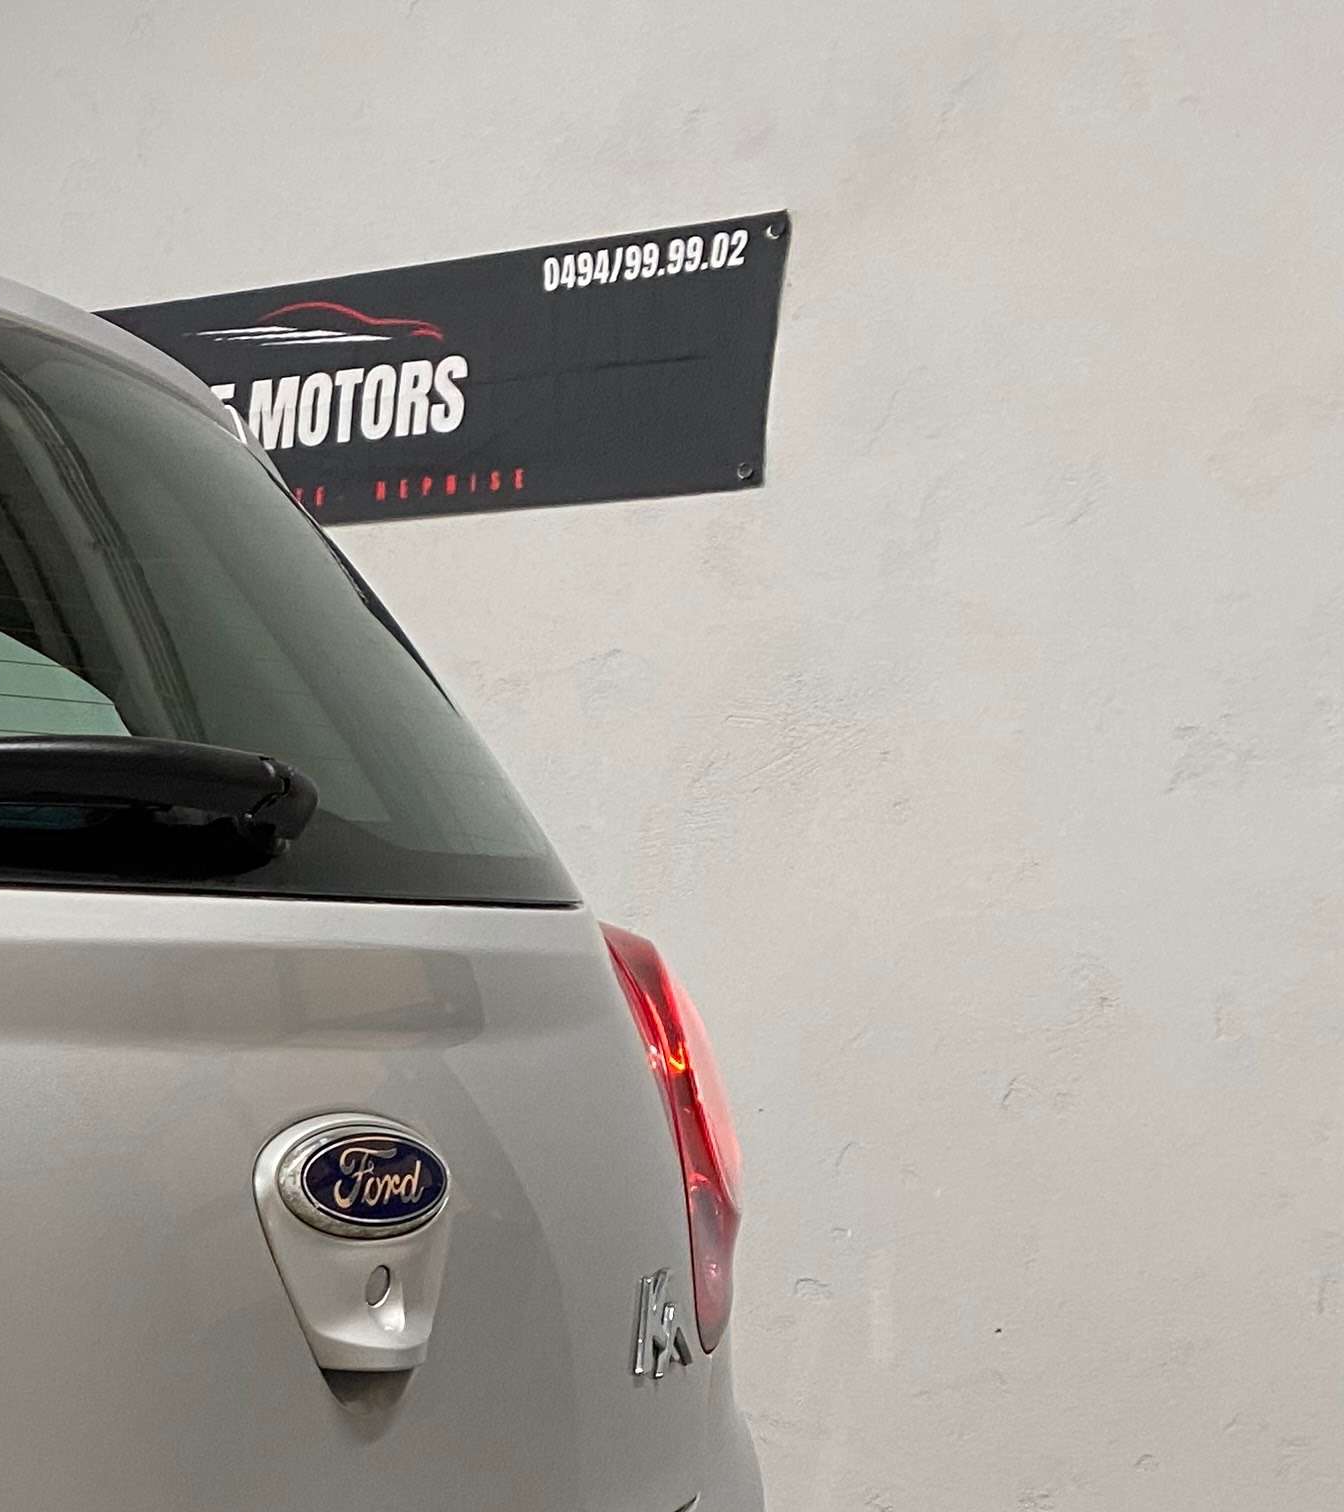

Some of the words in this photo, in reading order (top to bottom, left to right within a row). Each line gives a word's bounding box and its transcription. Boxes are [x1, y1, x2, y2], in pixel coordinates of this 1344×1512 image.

[543, 229, 749, 292] 0494/99.99.02
[249, 355, 468, 450] MOTORS
[333, 1146, 426, 1210] Ford
